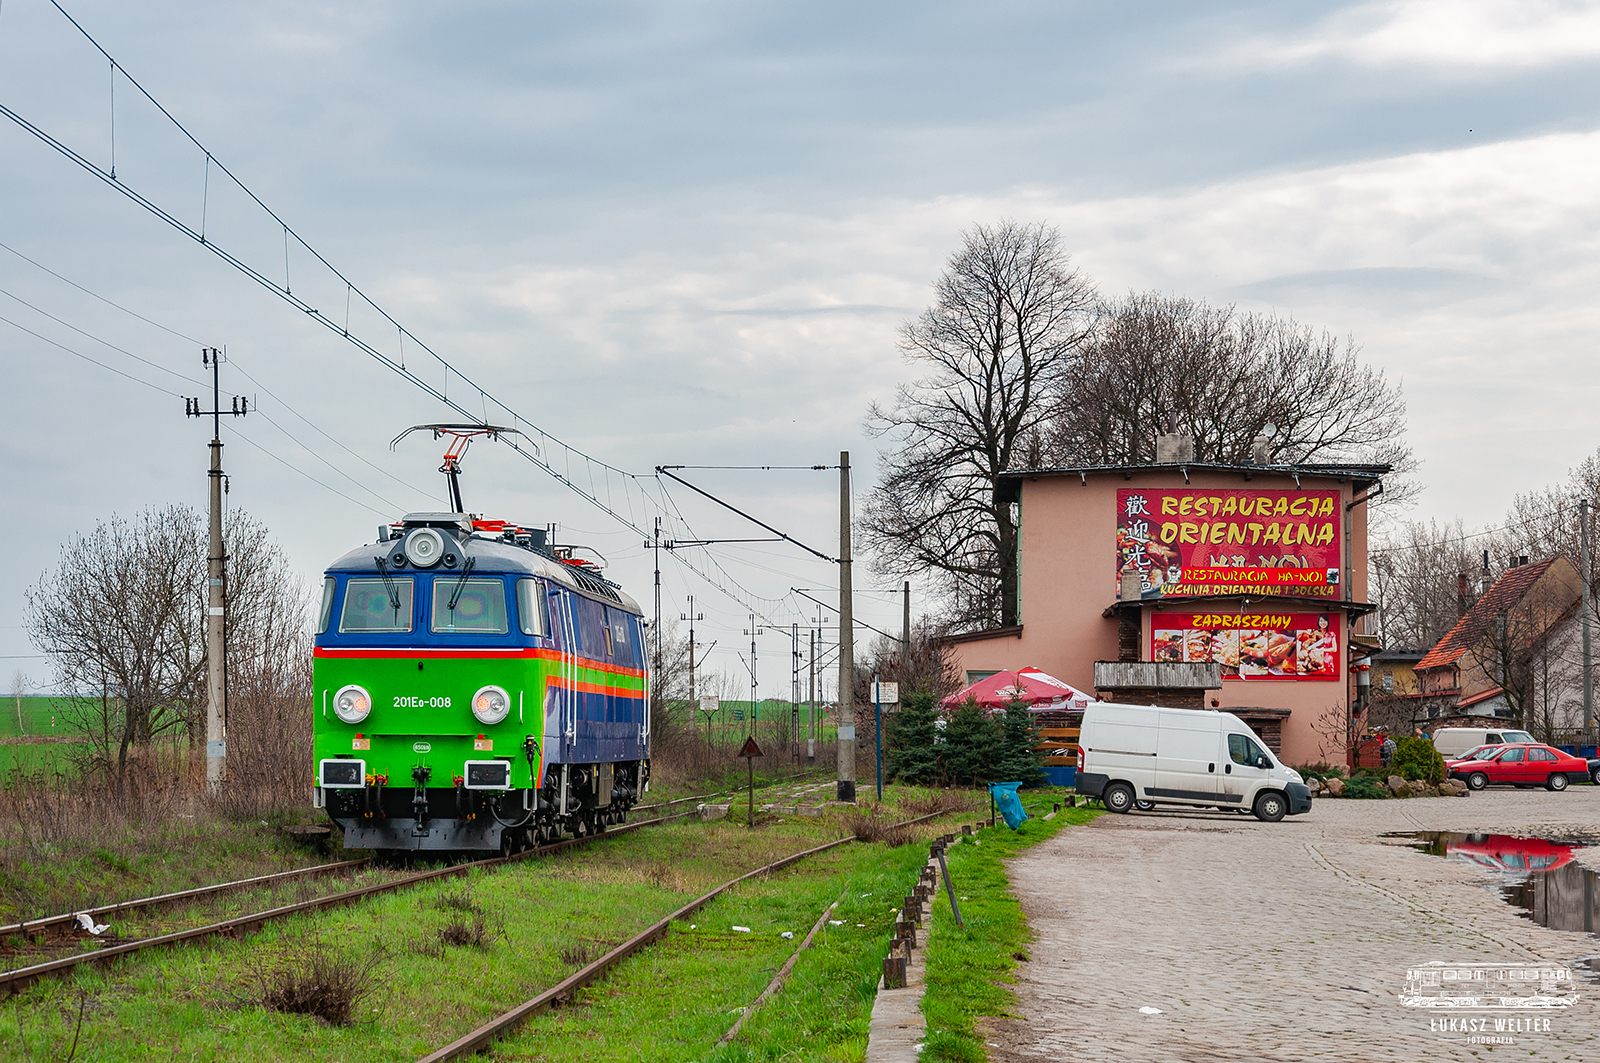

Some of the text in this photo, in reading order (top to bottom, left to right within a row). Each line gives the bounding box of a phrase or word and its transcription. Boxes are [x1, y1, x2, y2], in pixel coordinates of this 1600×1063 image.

[1161, 496, 1335, 518] RESTAURACJA
[1160, 522, 1335, 547] ORIENTALNA
[1183, 569, 1324, 583] RESTAURACJA HA-NOI
[1160, 584, 1210, 595] KUCHNIA
[1213, 584, 1282, 596] ORIENTALNA
[1293, 585, 1335, 597] POLSKA
[1192, 614, 1292, 629] ZAPRASZAMY
